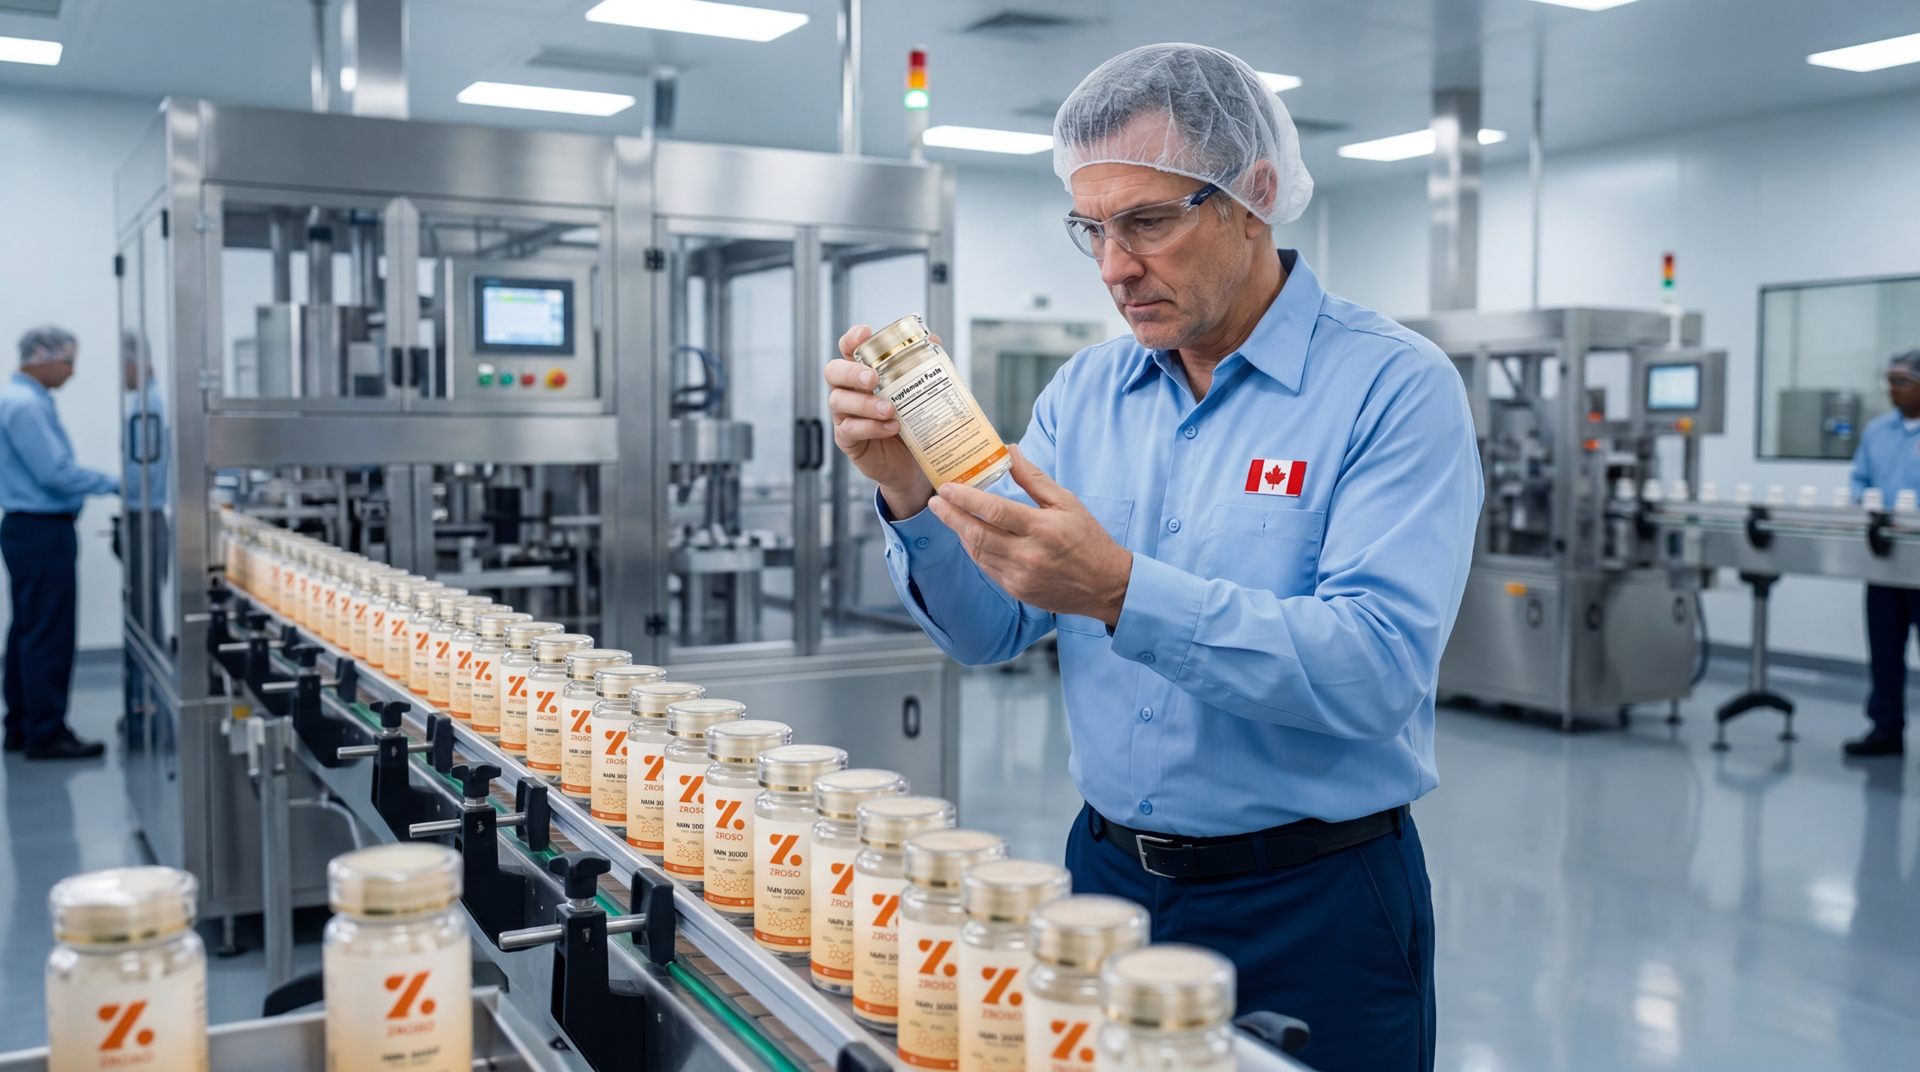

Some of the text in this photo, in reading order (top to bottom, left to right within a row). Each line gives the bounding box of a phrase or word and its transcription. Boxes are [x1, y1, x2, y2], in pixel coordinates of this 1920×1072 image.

[715, 831, 743, 841] ZROSO
[769, 867, 801, 878] ZROSO
[830, 898, 854, 909] ZROS
[871, 930, 899, 942] ZROS
